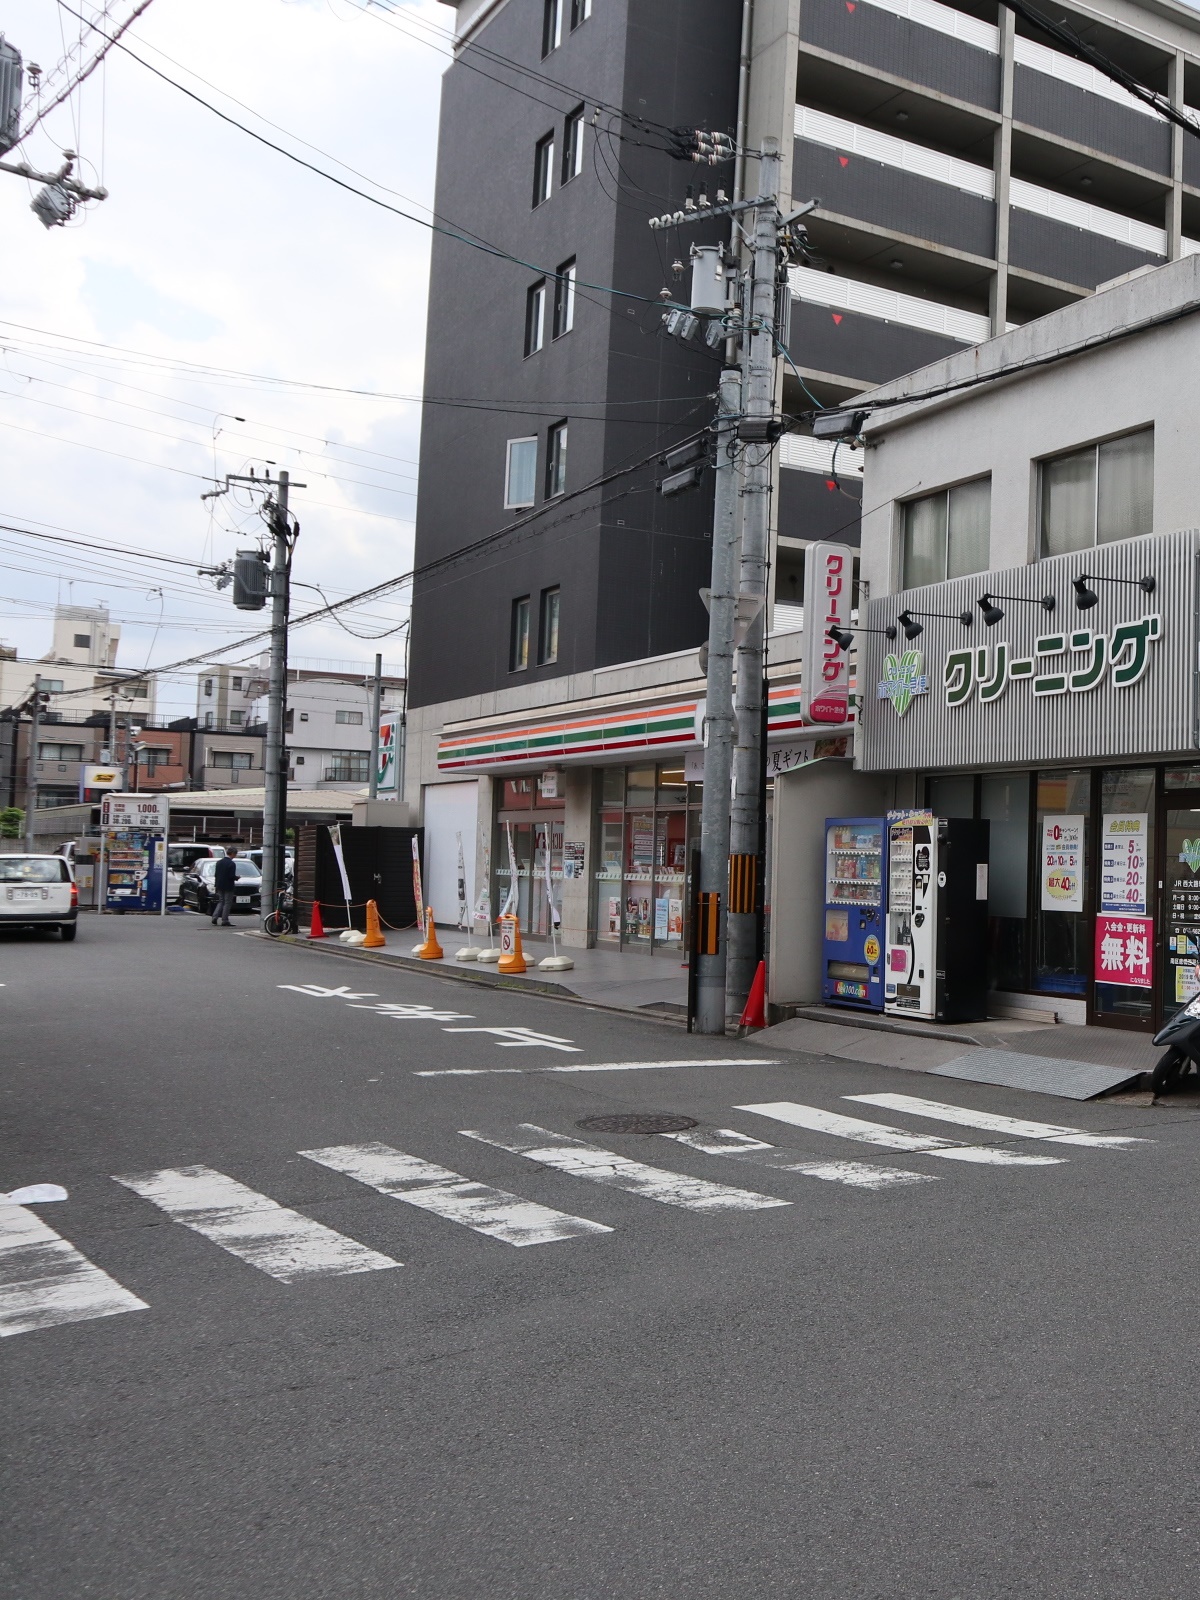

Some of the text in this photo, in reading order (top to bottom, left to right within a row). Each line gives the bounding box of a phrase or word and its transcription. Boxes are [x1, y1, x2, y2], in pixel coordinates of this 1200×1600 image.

[823, 554, 845, 682] クリーニング
[945, 614, 1163, 707] クリーニング
[877, 674, 928, 699] ホワイト急便
[1109, 819, 1141, 833] 会員特典
[1128, 839, 1135, 854] 5
[1127, 855, 1140, 869] 10
[1126, 871, 1139, 885] 20
[1126, 889, 1139, 902] 40
[1104, 921, 1147, 934] 入会金・更新料
[1101, 932, 1150, 975] 無料
